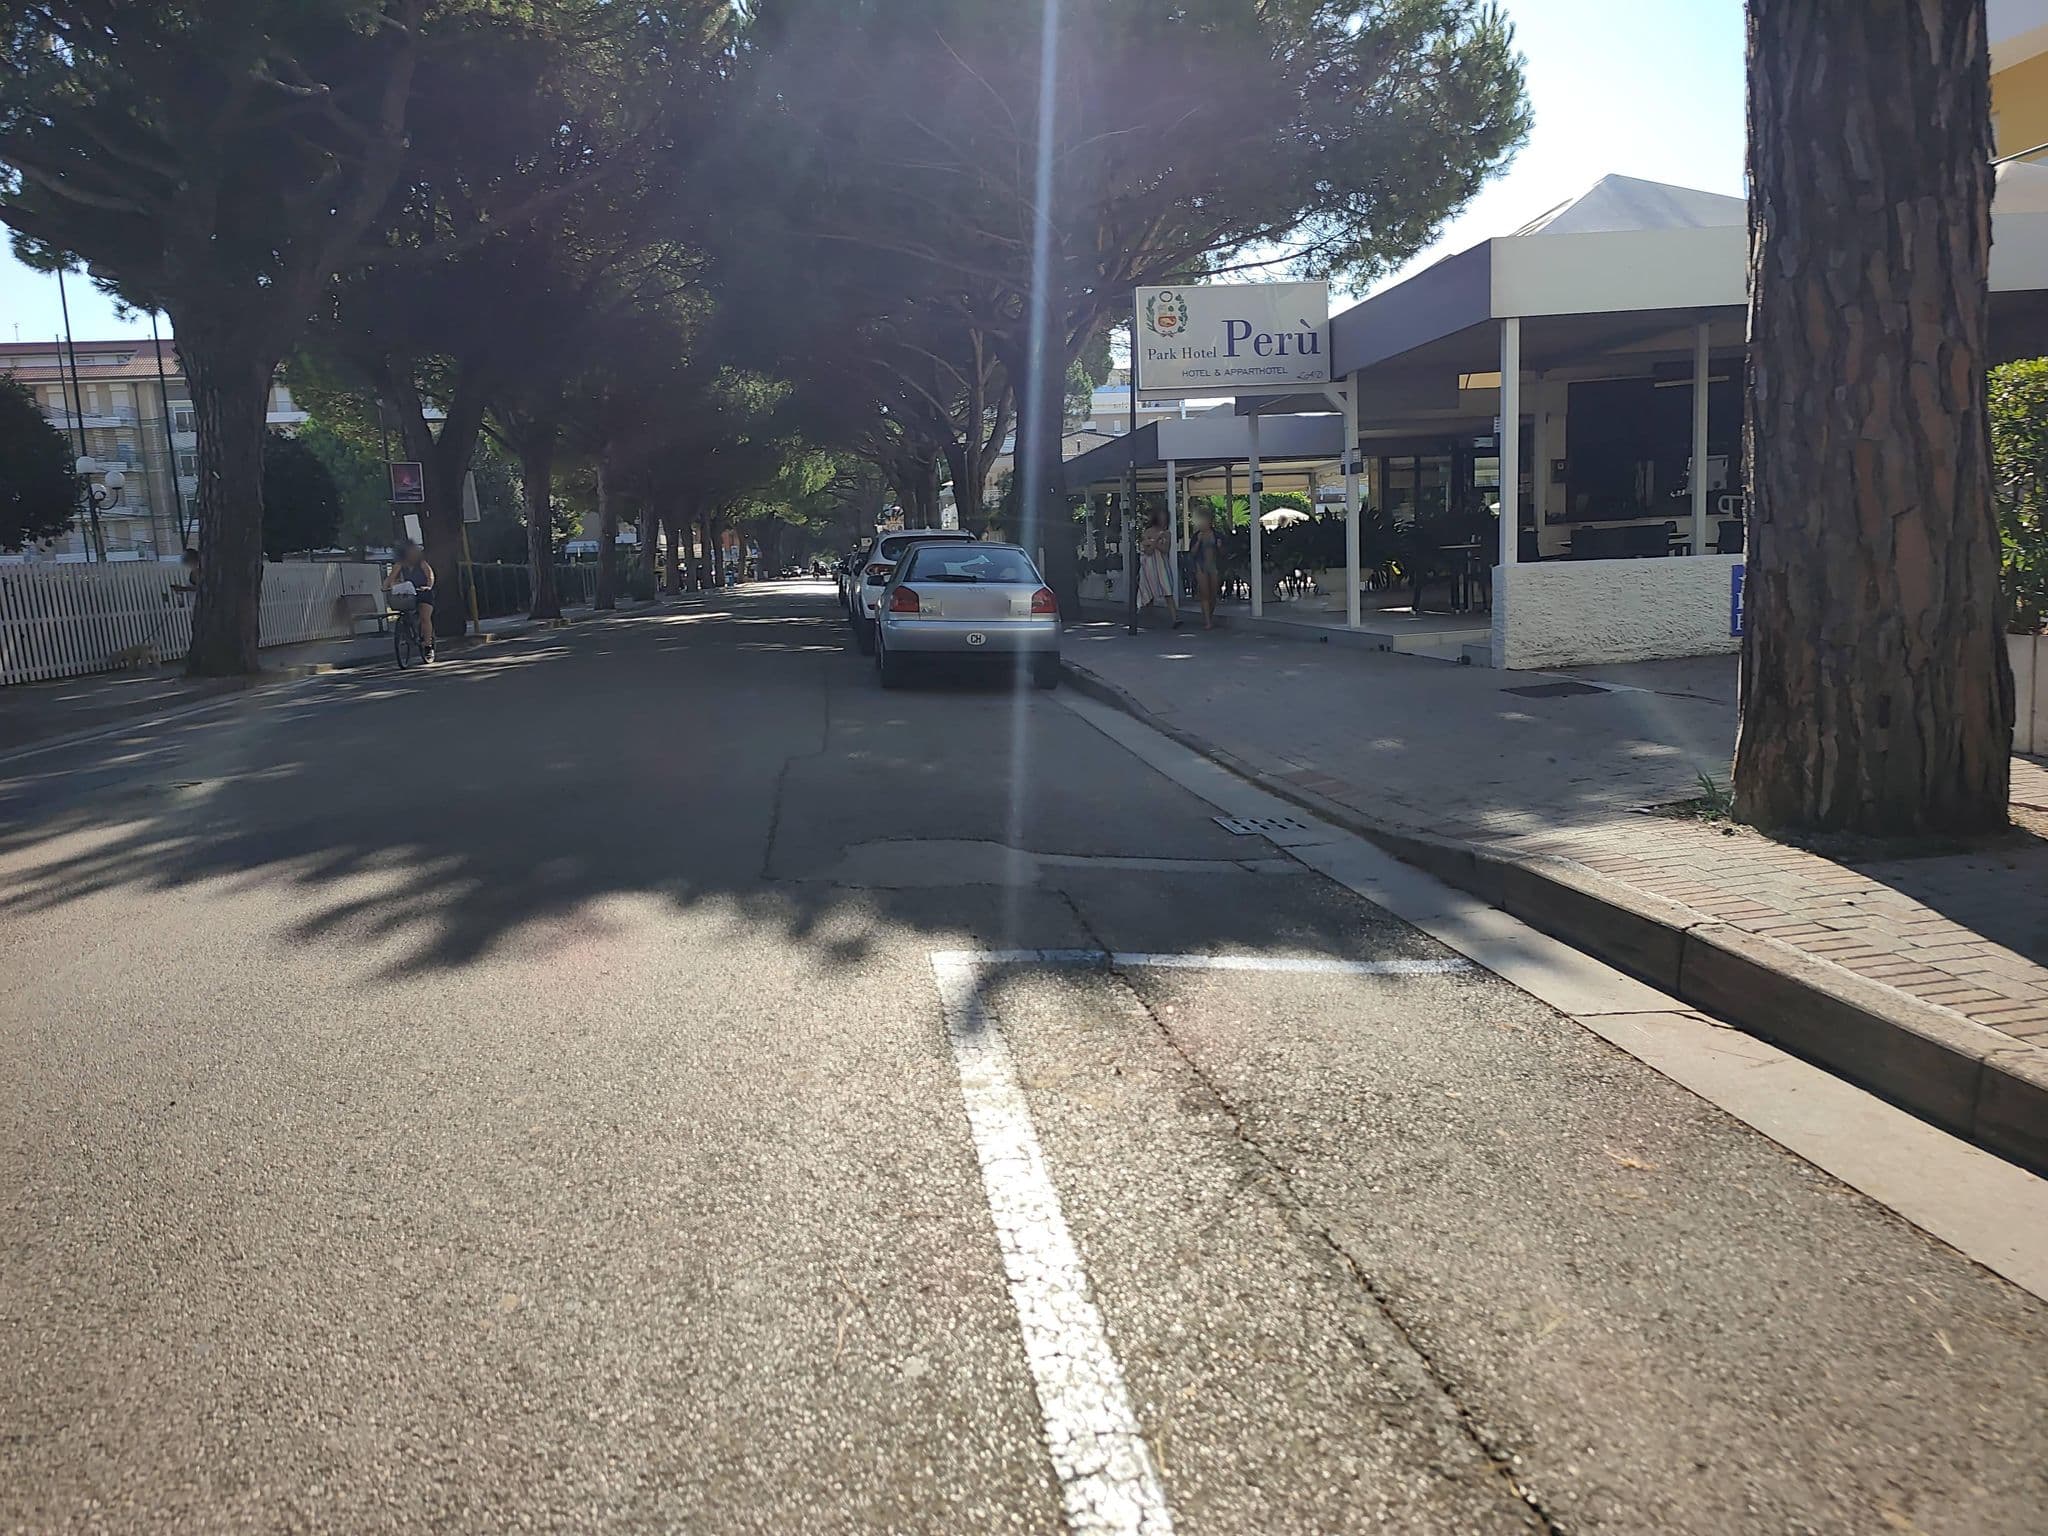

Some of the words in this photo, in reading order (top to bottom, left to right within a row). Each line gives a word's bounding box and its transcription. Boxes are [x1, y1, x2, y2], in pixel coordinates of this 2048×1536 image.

[1147, 348, 1178, 361] Park
[1181, 346, 1218, 360] Hotel
[1221, 318, 1321, 358] Perù
[1182, 368, 1212, 378] HOTEL
[1214, 368, 1222, 377] &
[1224, 366, 1289, 377] APPARTHOTEL
[970, 633, 983, 644] CH
